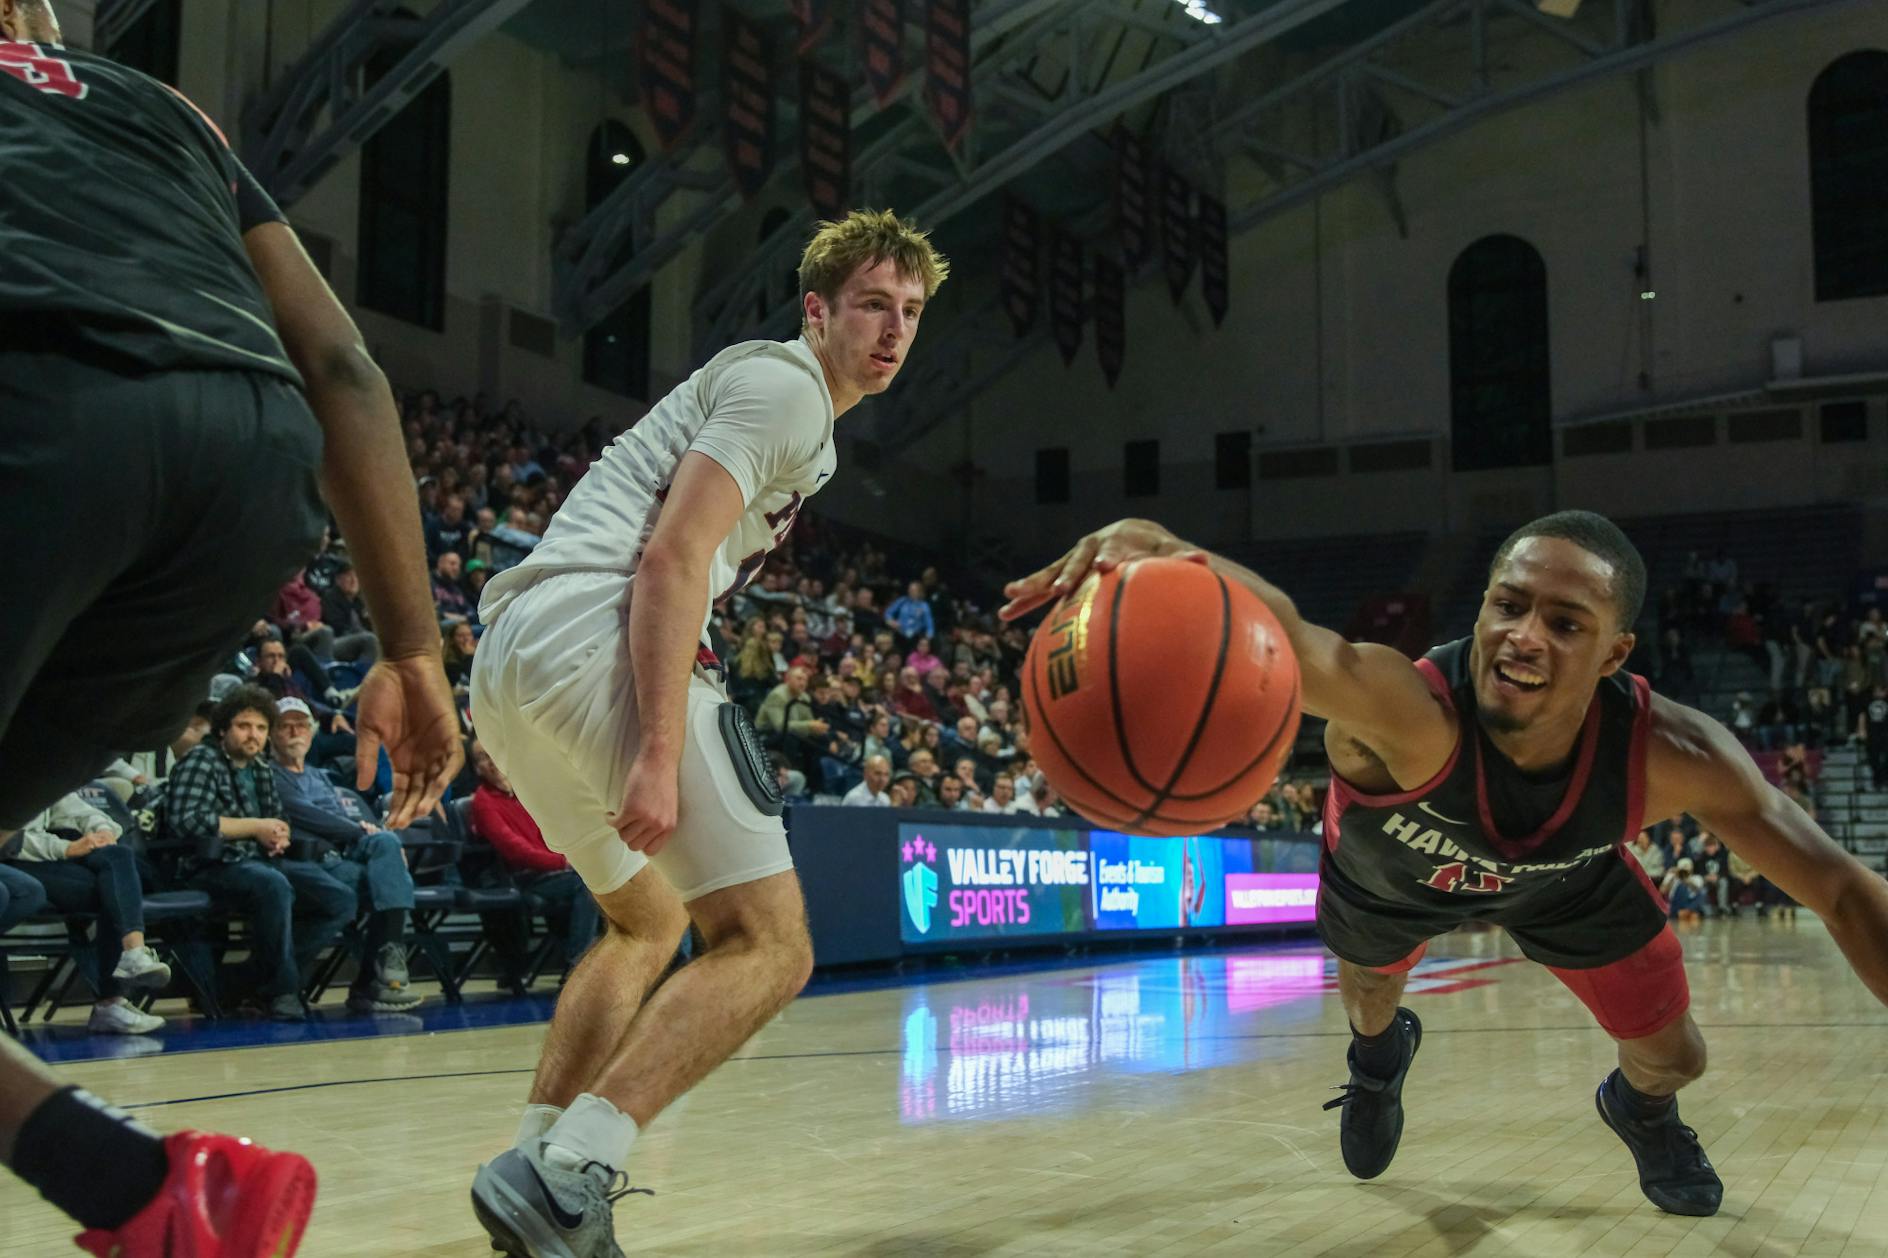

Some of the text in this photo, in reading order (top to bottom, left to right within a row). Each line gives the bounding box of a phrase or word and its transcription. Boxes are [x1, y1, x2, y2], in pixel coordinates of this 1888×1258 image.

[947, 848, 1089, 885] VALLEY FORGE
[949, 889, 1030, 927] SPORTS
